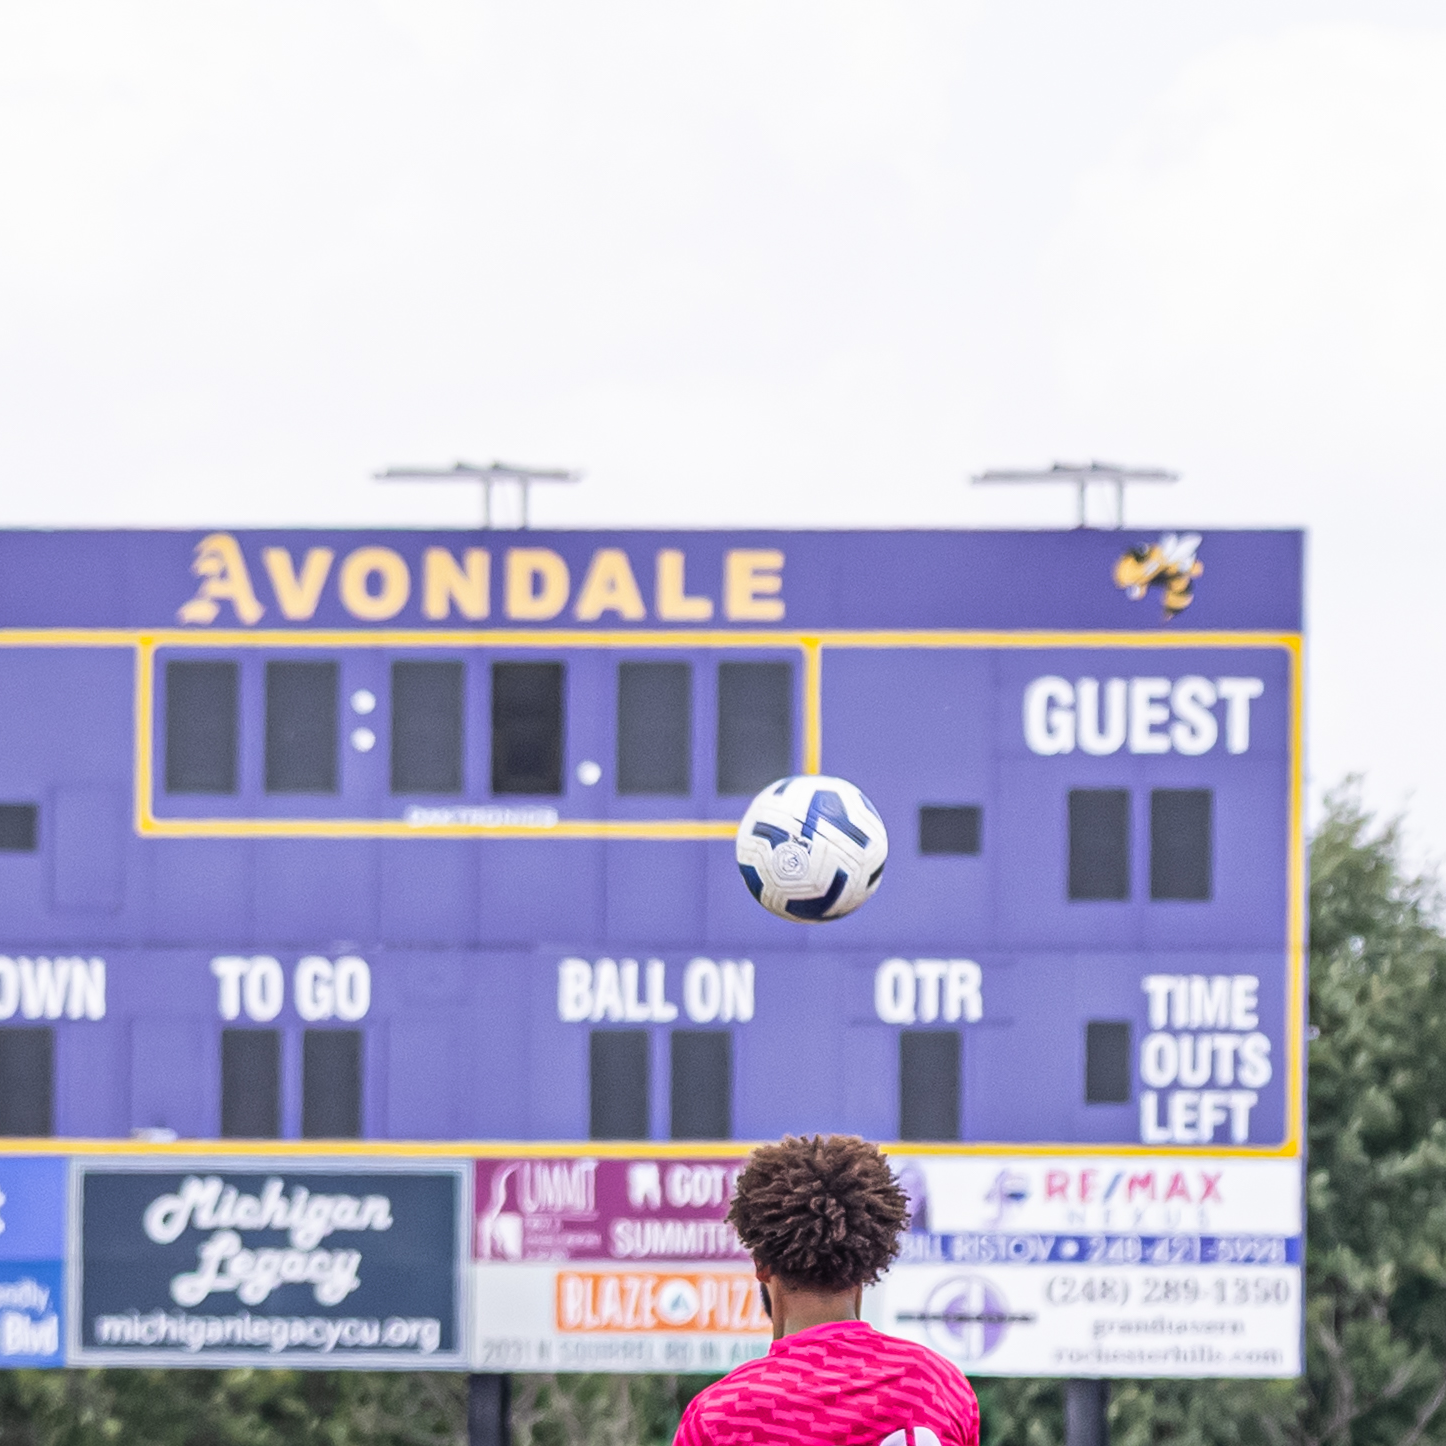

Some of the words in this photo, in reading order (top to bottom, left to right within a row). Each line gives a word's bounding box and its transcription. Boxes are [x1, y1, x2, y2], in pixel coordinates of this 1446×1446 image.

[180, 533, 786, 626] AVONDALE
[1023, 675, 1264, 756] GUEST
[211, 957, 285, 1022] TO
[294, 957, 372, 1022] GO
[557, 958, 678, 1024] BALL
[683, 958, 756, 1024] ON
[873, 958, 984, 1025] QTR
[1140, 975, 1259, 1031] TIME
[1139, 1033, 1272, 1088] OUTS
[1140, 1091, 1258, 1144] LEFT
[143, 1175, 393, 1251] Michigan
[665, 1163, 727, 1208] GOT
[1043, 1168, 1224, 1202] RE/MAX
[170, 1229, 361, 1306] Legacy
[1045, 1275, 1130, 1306] (248)
[559, 1273, 657, 1329] BLAZE
[697, 1276, 773, 1329] PIZZ
[94, 1308, 442, 1354] michiganlegacycu.org
